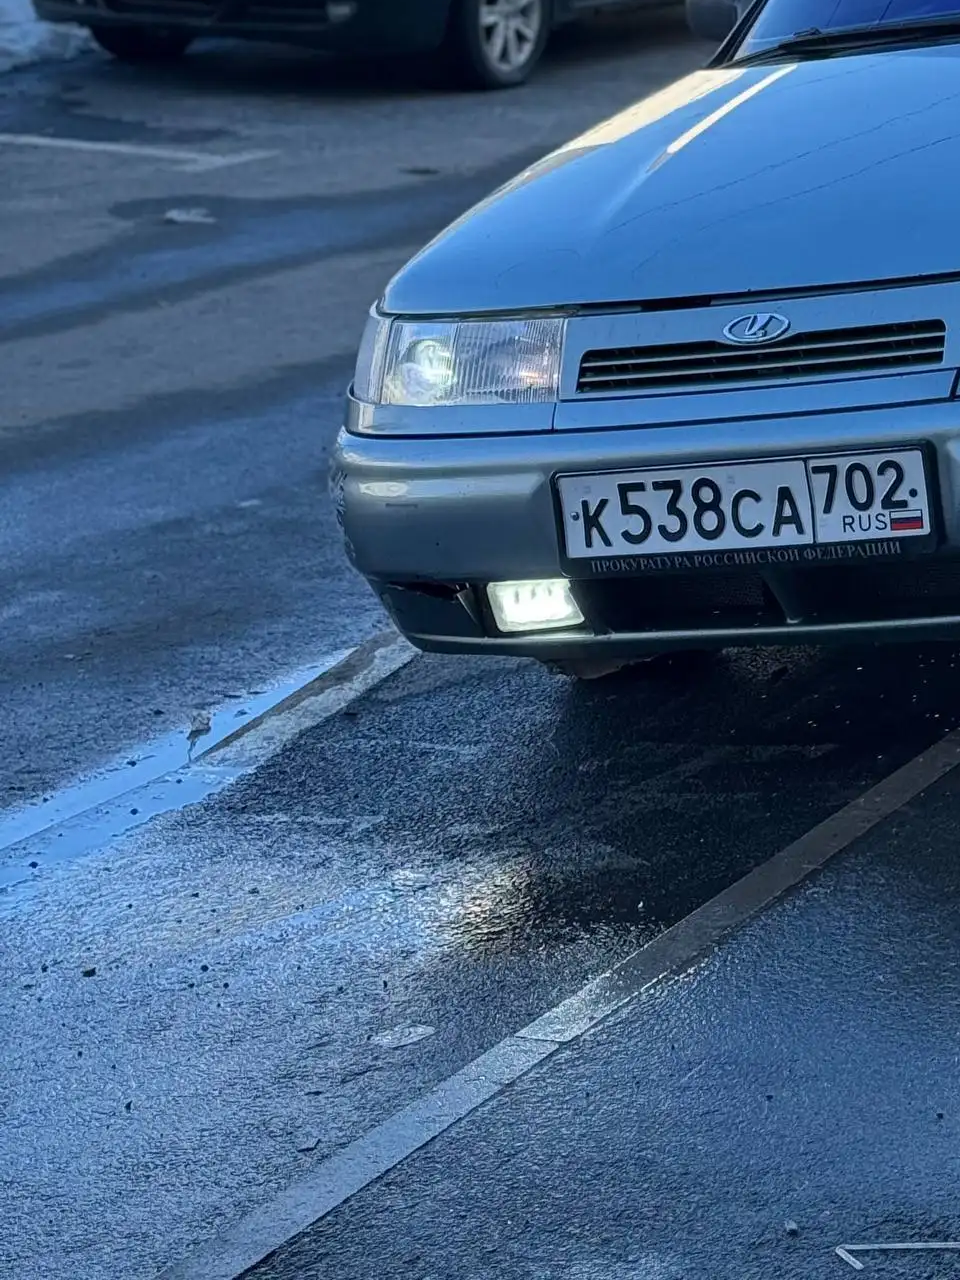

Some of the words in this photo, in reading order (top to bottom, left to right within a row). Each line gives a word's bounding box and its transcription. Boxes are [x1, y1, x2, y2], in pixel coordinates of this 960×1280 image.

[580, 477, 804, 548] К538СА
[811, 460, 908, 514] 702
[841, 512, 888, 533] RUS
[590, 556, 692, 573] ПРОКУРАТУРА
[693, 549, 800, 568] РОССИЙСКОЙ
[803, 541, 902, 560] ФЕДЕРАЦИИ
